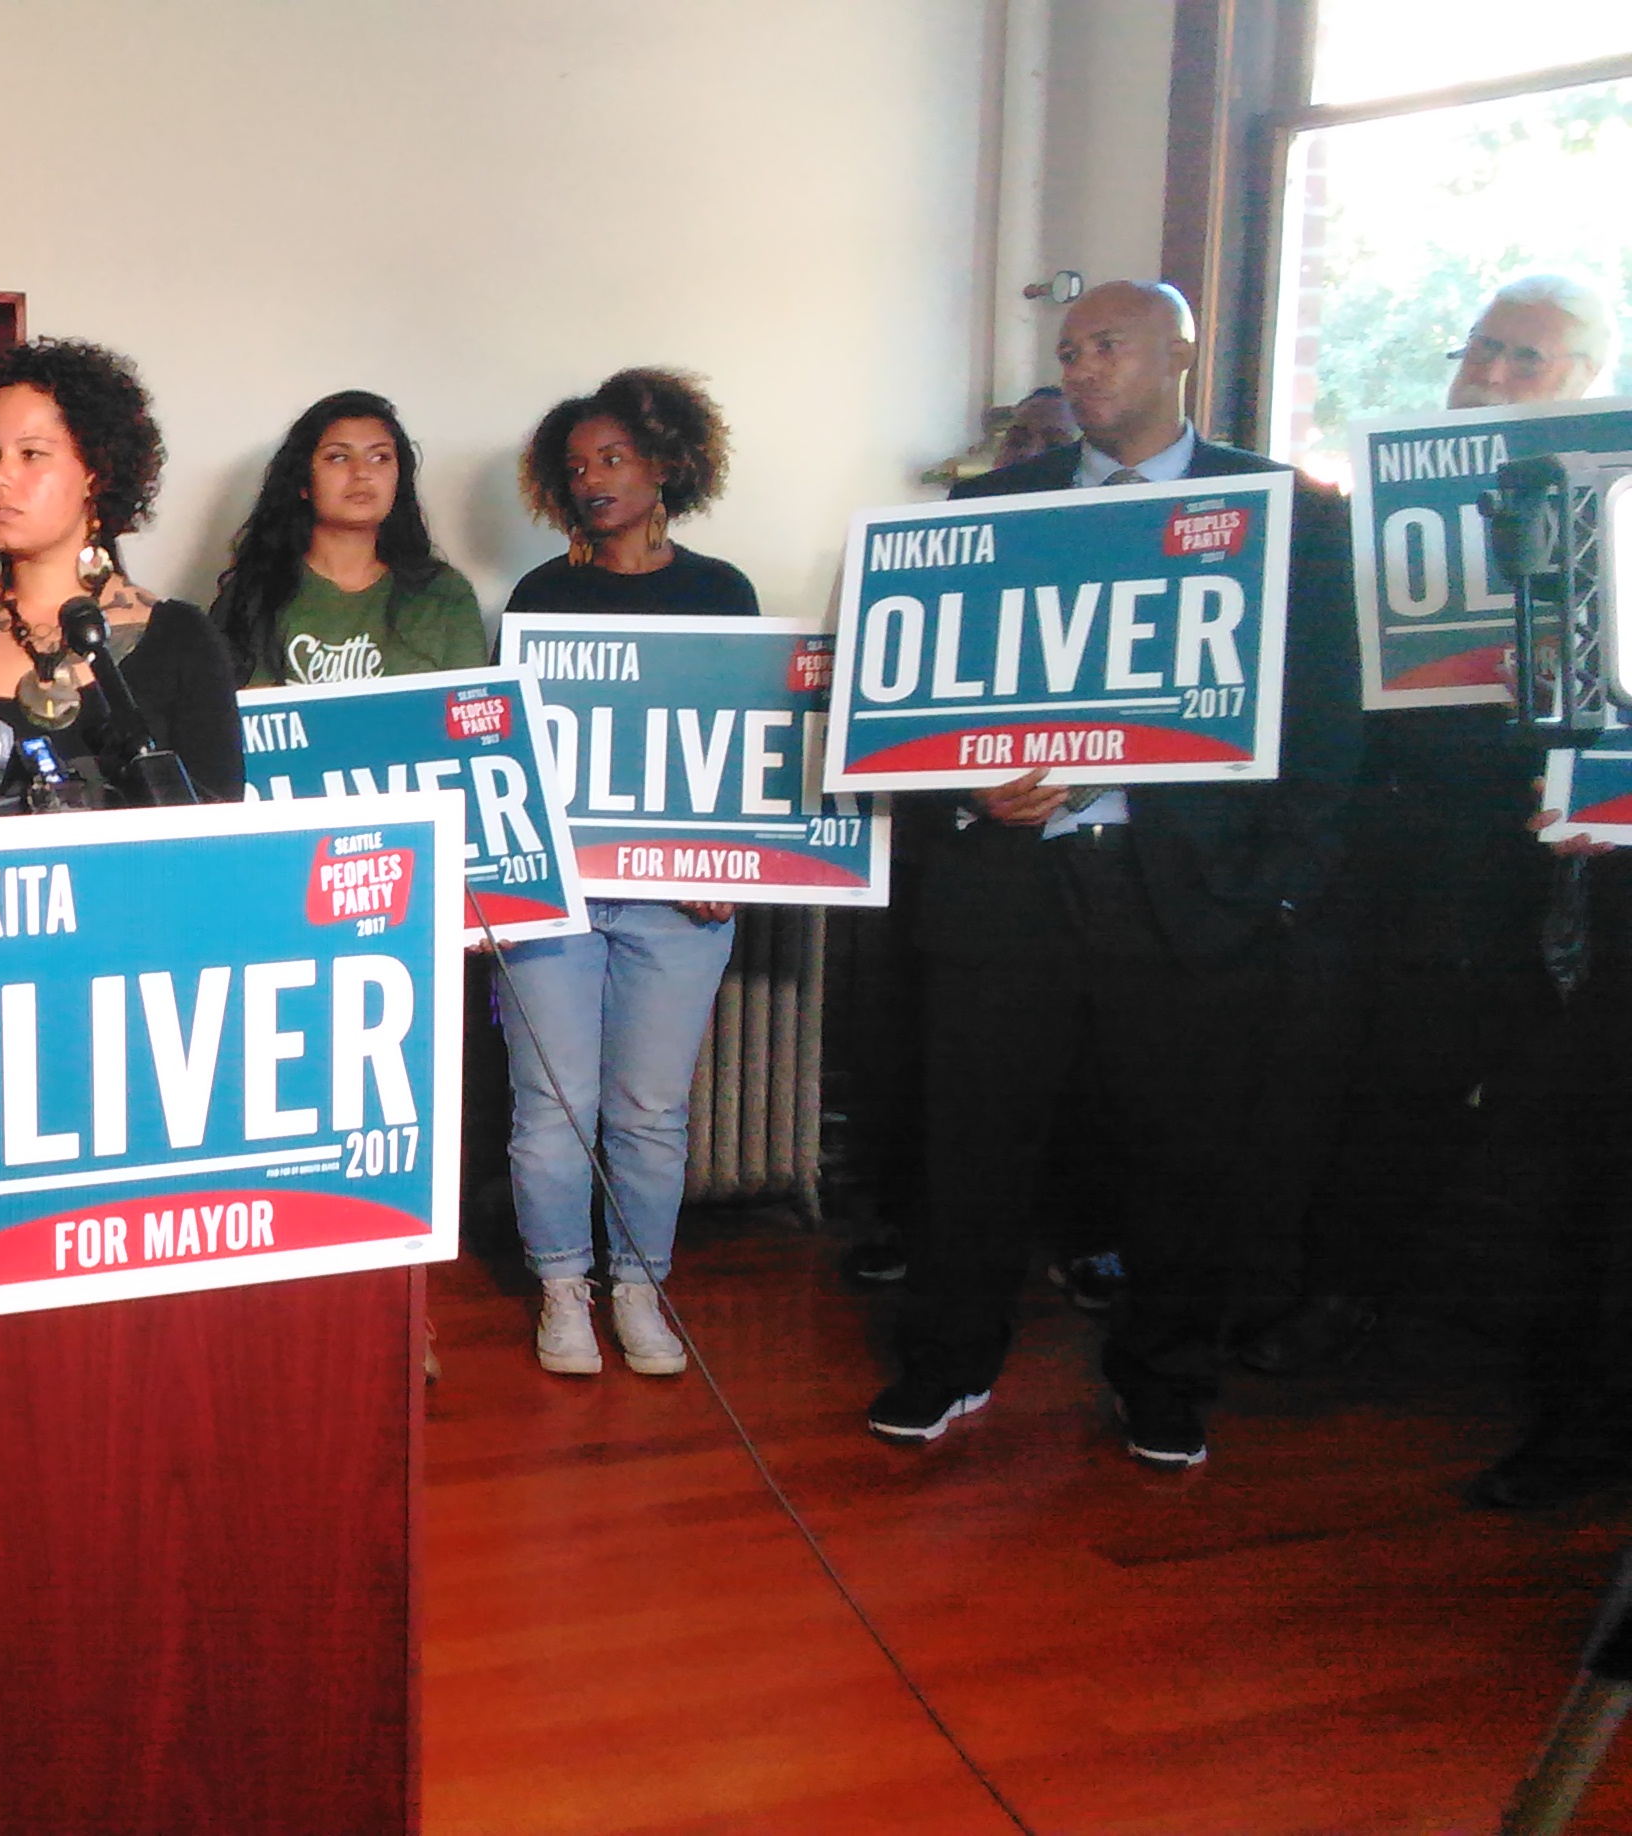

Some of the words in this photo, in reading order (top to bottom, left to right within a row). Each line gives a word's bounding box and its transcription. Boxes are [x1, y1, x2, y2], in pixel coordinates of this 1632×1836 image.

[1378, 433, 1510, 483] NIKKITA
[1173, 510, 1240, 537] PEOPLES
[1181, 528, 1232, 551] PARTY
[870, 524, 995, 572] NIKKITA
[860, 575, 1245, 703] OLIVER
[285, 632, 385, 686] Seattle
[527, 640, 640, 681] NIKKITA
[451, 698, 504, 722] PEOPLES
[1181, 686, 1245, 719] 2017
[461, 714, 501, 735] PARTY
[959, 735, 1012, 766] FOR
[1023, 729, 1124, 763] MAYOR
[334, 831, 383, 856] SEATTLE
[809, 817, 861, 847] 2017
[320, 854, 402, 892] PEOPLES
[499, 852, 548, 884] 2017
[617, 846, 663, 878] FOR
[674, 847, 761, 880] MAYOR
[332, 882, 393, 917] PARTY
[356, 916, 386, 937] 2017
[346, 1125, 419, 1179] 2017
[55, 1221, 129, 1271] FOR
[144, 1199, 275, 1261] MAYOR
